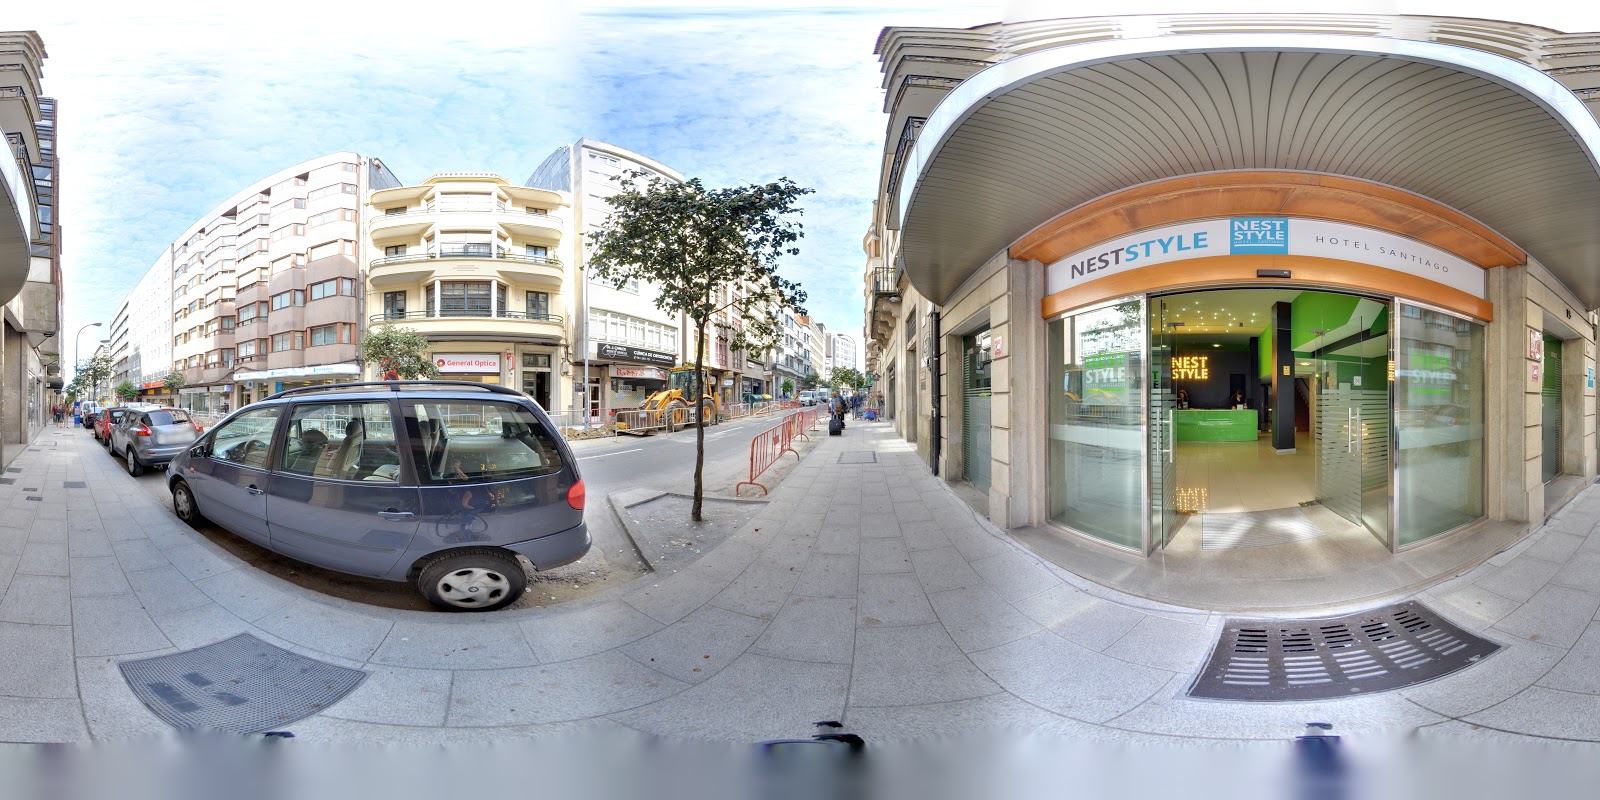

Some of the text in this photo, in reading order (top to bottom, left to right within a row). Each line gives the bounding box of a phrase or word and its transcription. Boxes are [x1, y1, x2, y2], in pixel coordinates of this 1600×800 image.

[1234, 220, 1284, 230] NEST
[1234, 231, 1284, 240] STYLE
[1316, 236, 1448, 272] HOTEL SANTIAGO
[1172, 356, 1208, 368] NEST
[1086, 367, 1126, 384] STYLE
[1172, 368, 1208, 380] STYLE
[1412, 369, 1450, 384] STYLE
